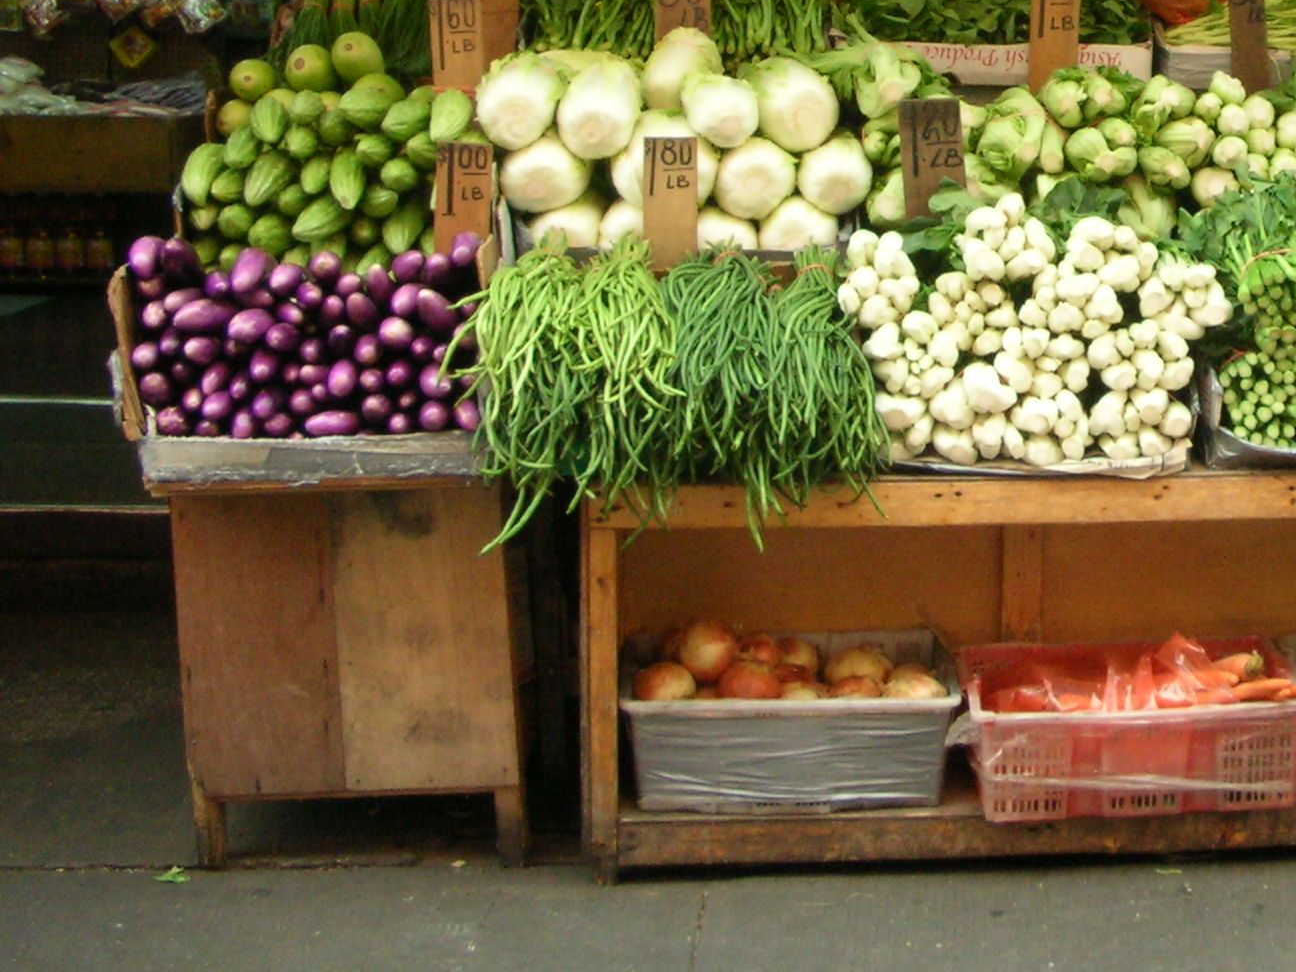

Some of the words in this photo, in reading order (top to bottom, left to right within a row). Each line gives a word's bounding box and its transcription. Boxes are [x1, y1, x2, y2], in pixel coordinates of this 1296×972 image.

[1050, 13, 1075, 32] LB
[450, 39, 475, 54] LB
[666, 173, 691, 190] LB
[460, 184, 485, 202] LB
